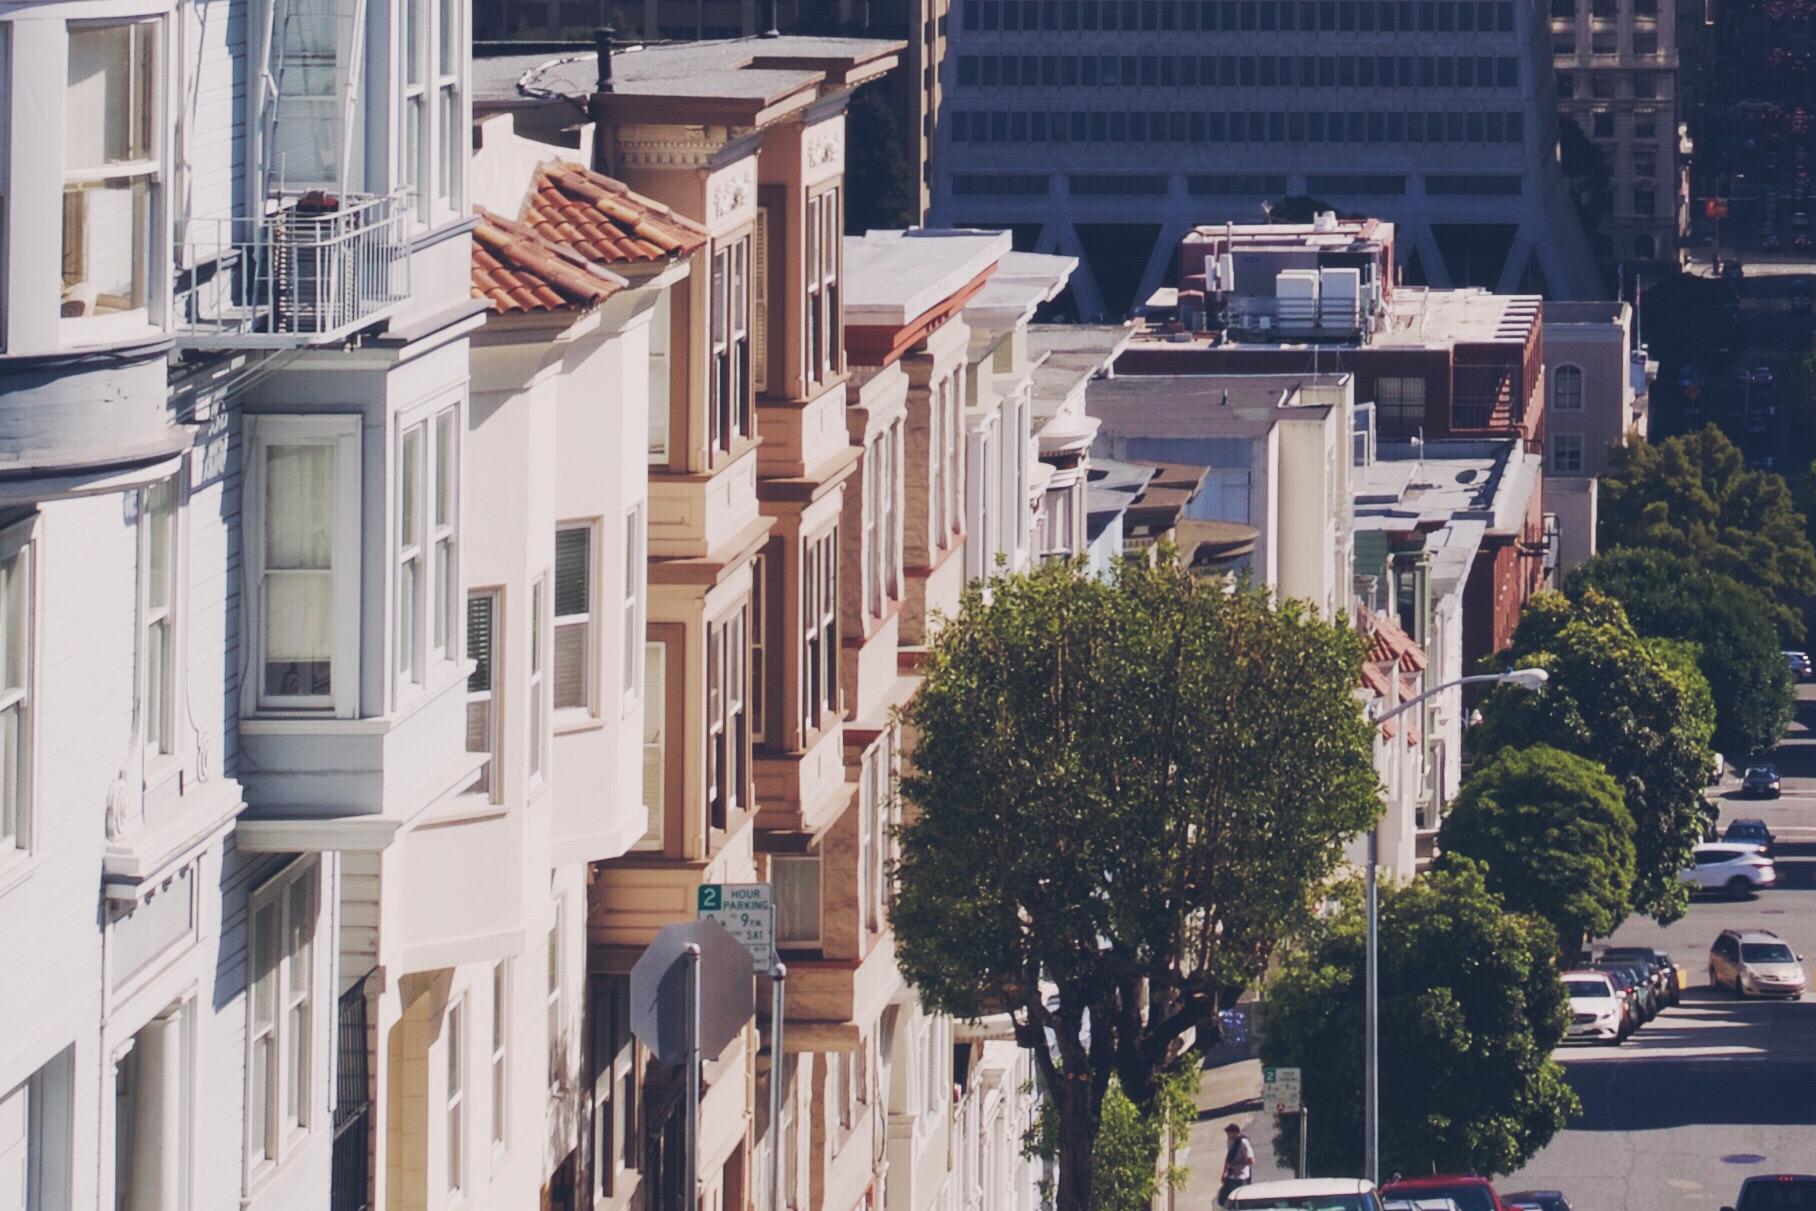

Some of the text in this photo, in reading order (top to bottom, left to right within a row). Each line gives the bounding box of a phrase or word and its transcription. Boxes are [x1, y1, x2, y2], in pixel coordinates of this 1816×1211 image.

[703, 888, 760, 907] 2 HOUR
[723, 901, 768, 910] PARKING
